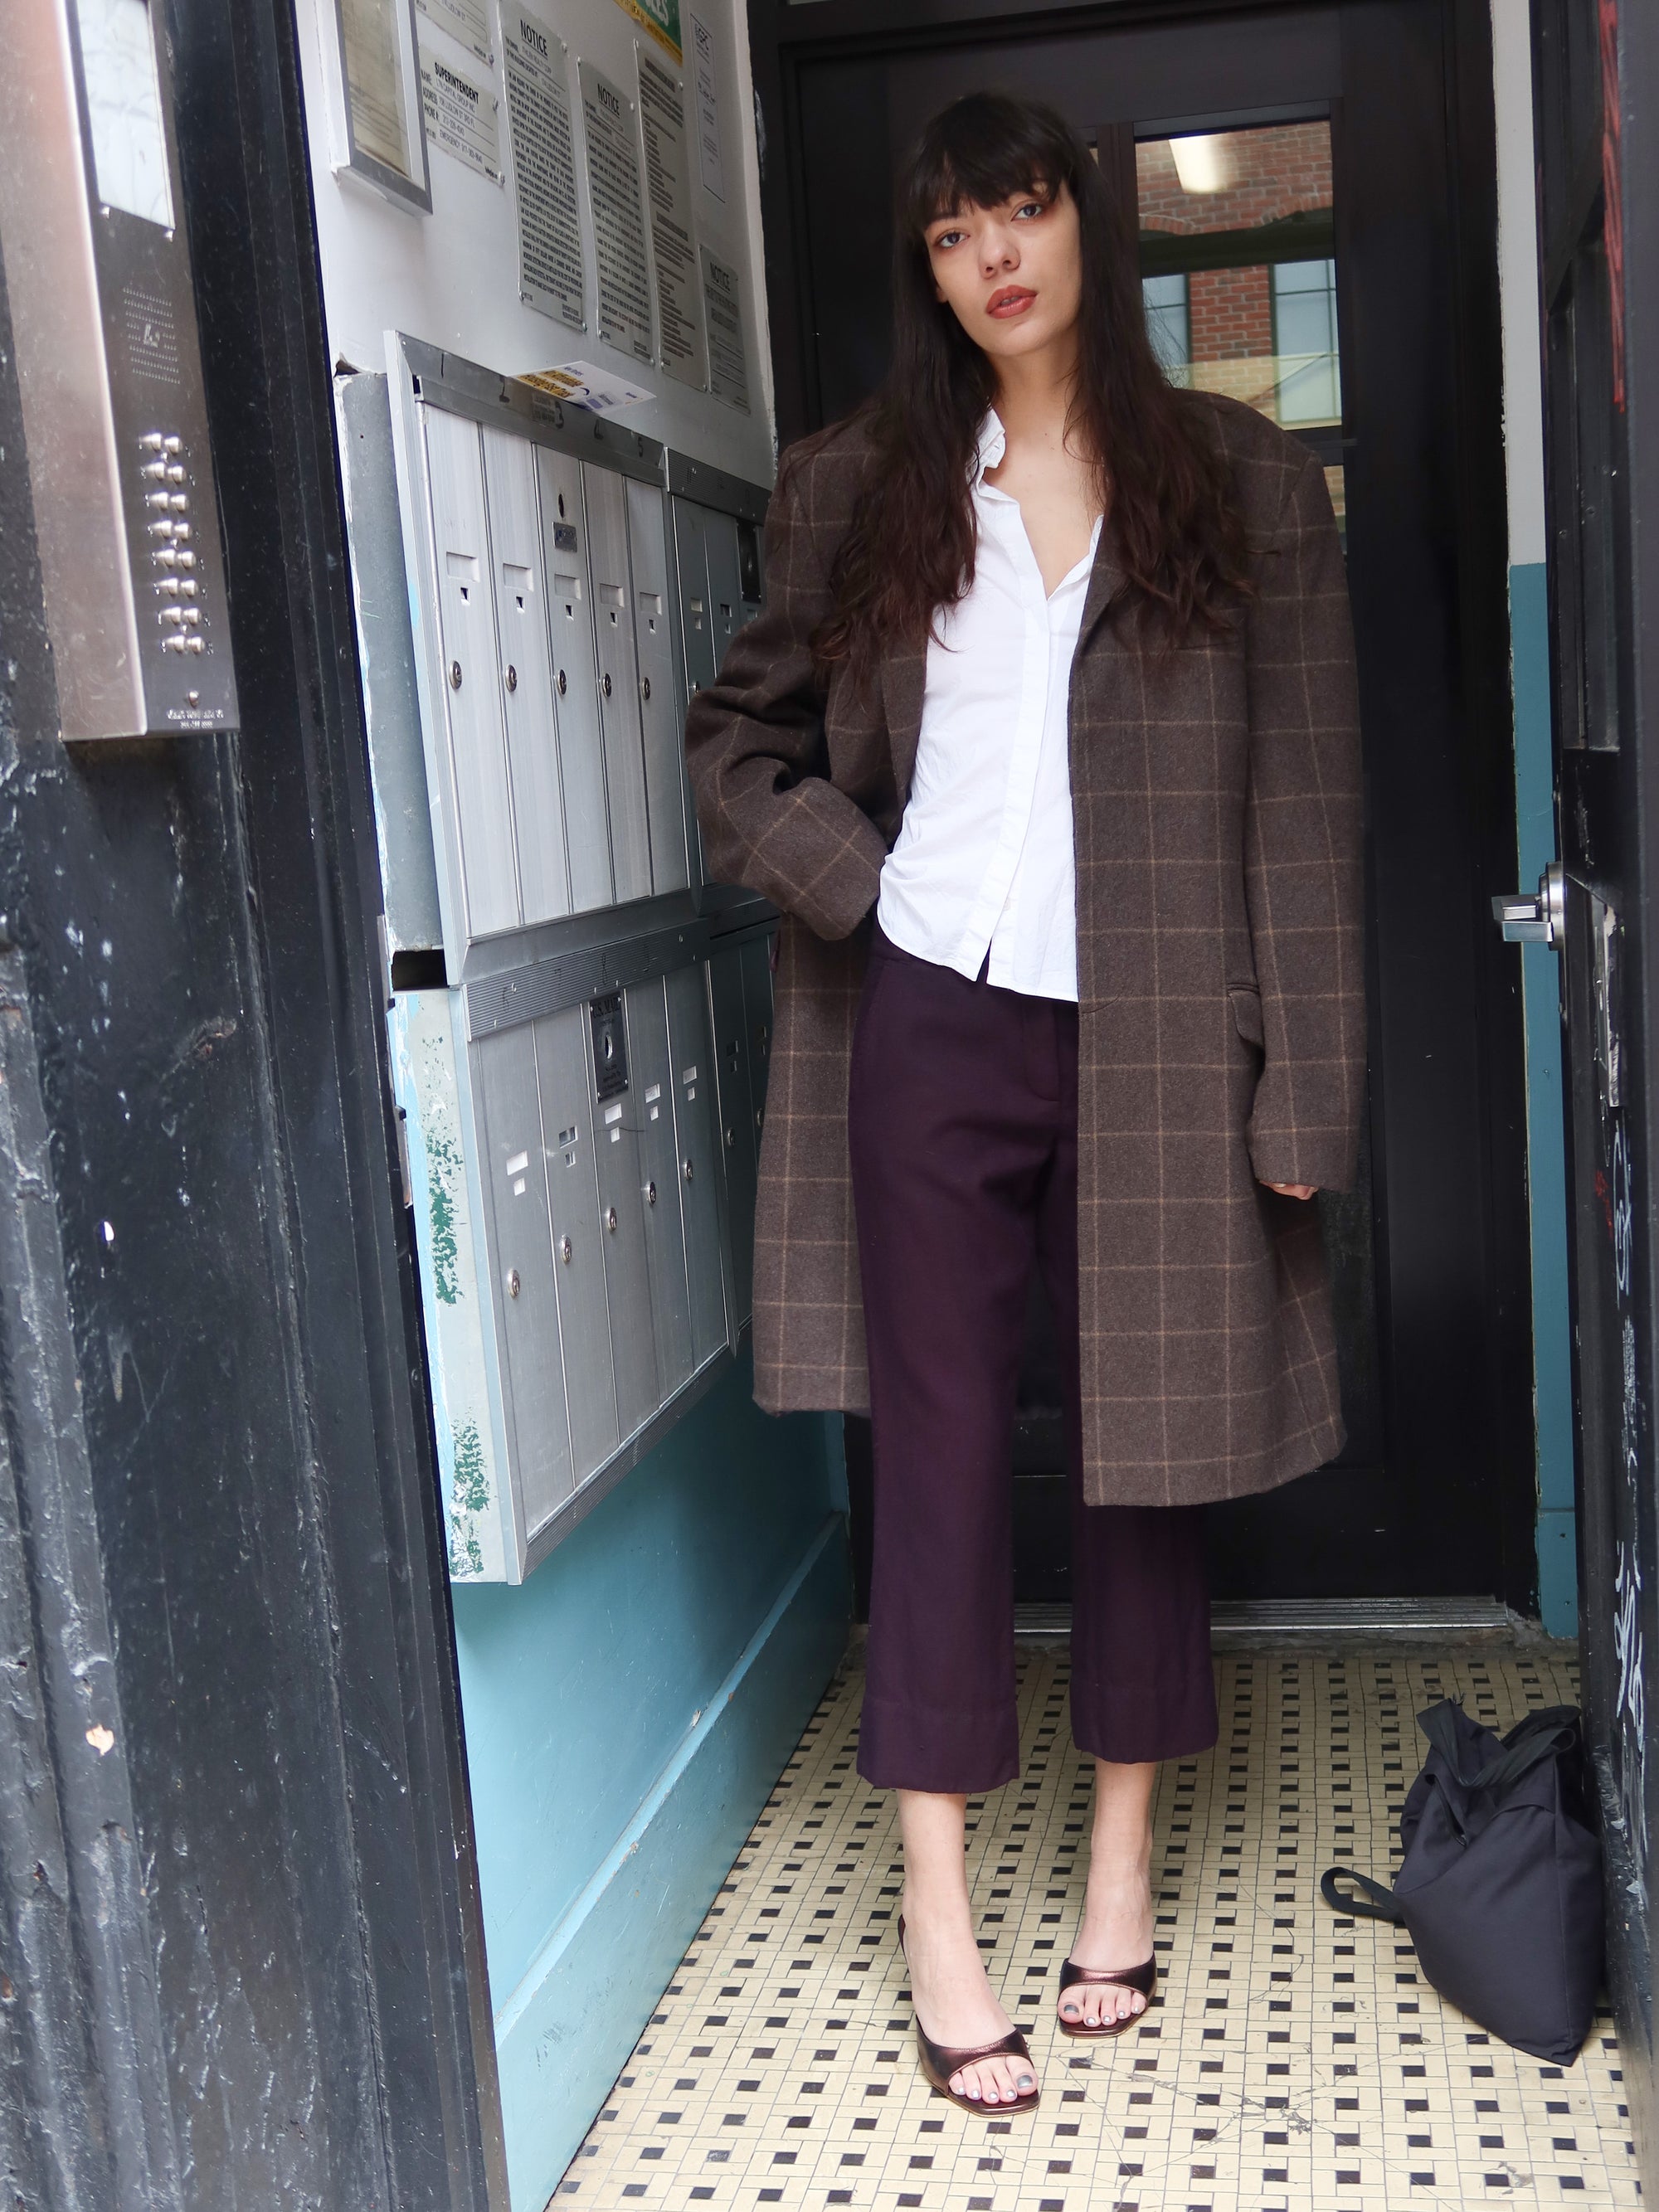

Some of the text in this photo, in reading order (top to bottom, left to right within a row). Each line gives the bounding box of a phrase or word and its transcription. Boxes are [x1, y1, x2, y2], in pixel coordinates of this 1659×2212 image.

[520, 18, 547, 56] NOTICE
[434, 62, 479, 105] SUPERINTENDENT
[597, 83, 620, 116] NOTICE
[710, 261, 730, 292] NOTICE
